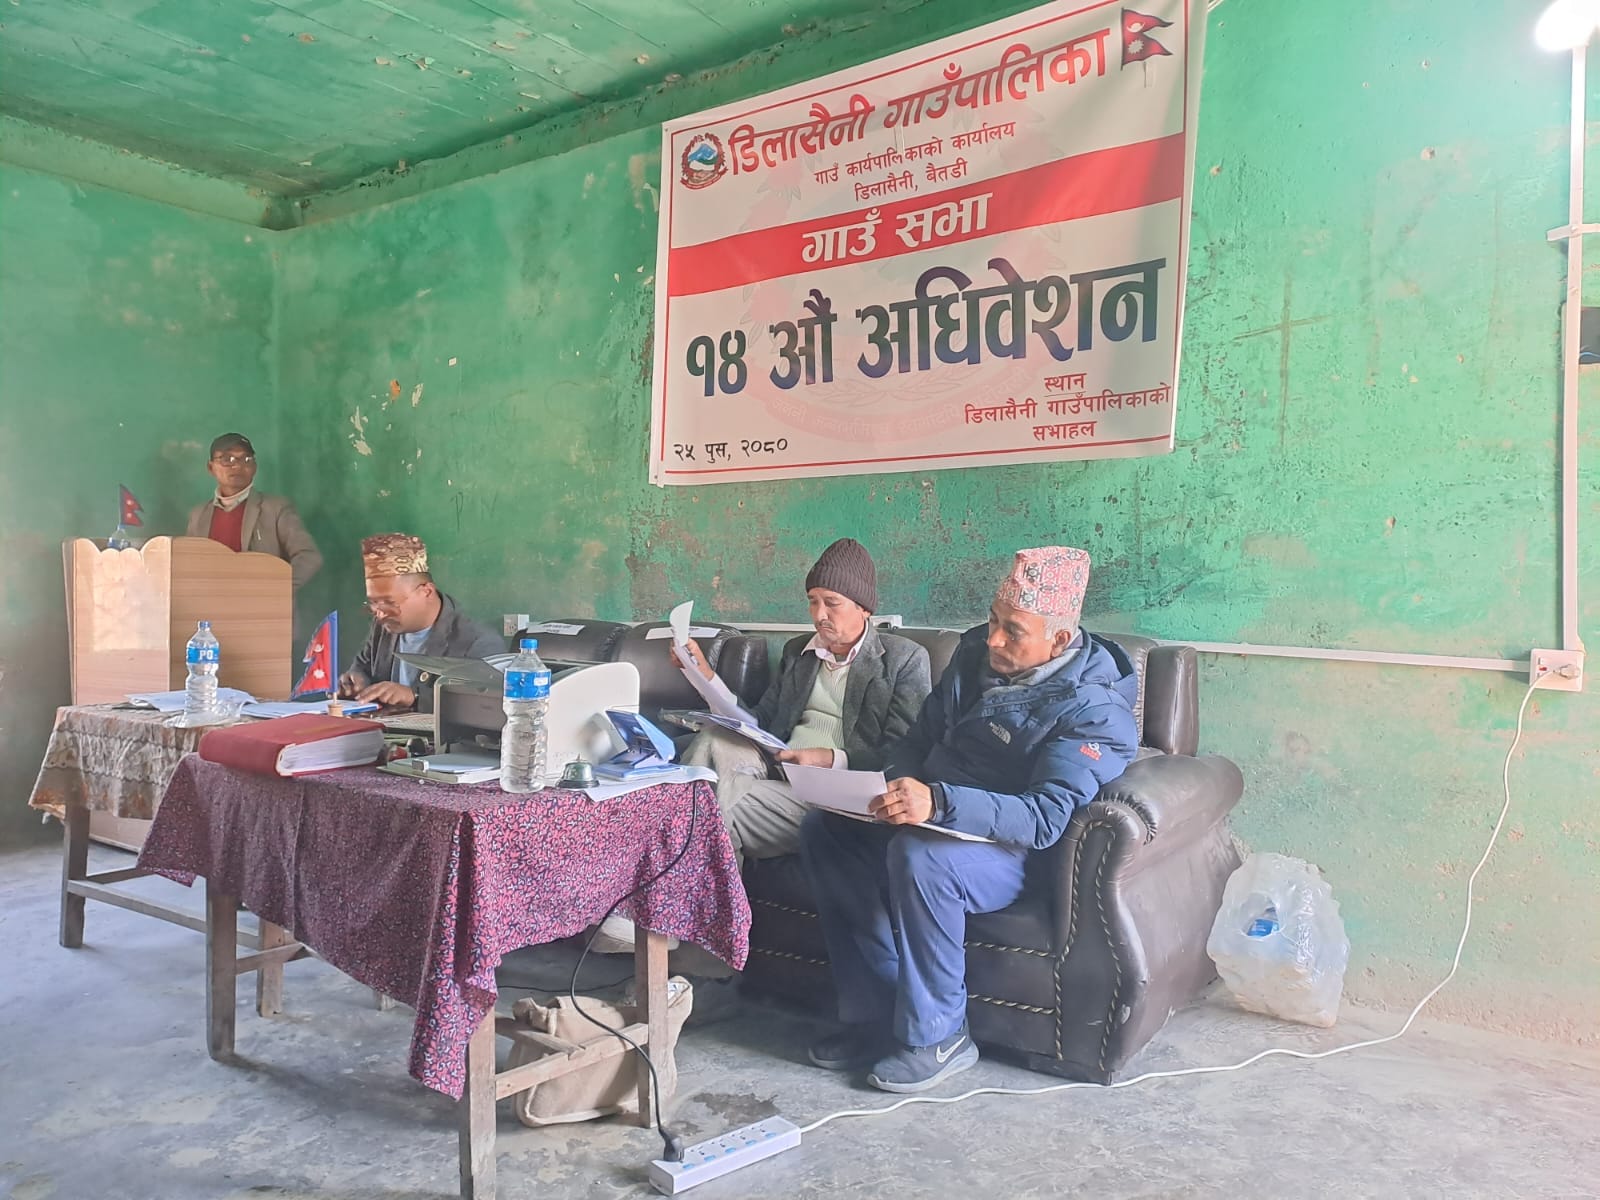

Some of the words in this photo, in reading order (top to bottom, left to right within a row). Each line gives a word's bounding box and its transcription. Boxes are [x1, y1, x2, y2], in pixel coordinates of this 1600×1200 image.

[728, 94, 875, 175] डिलासैनी
[883, 28, 1110, 128] गाउँपालिका
[814, 163, 839, 184] गाउँ
[845, 136, 943, 176] कार्यपालिकाको
[951, 122, 1016, 150] कार्यालय
[854, 169, 918, 201] डिलासैनी,
[925, 156, 968, 183] बैतडी
[801, 207, 882, 263] गाउँ
[895, 192, 993, 248] सभा
[686, 329, 748, 397] १४
[769, 288, 838, 390] औ
[855, 257, 1167, 379] अधिवेशन
[964, 397, 1038, 424] डिलासैनी
[1047, 382, 1171, 416] गाउँपालिकाको
[1044, 373, 1087, 392] स्थान
[673, 444, 696, 461] २५
[705, 442, 731, 464] पुस,
[740, 438, 788, 457] २०८०
[1033, 420, 1097, 441] सभाहल
